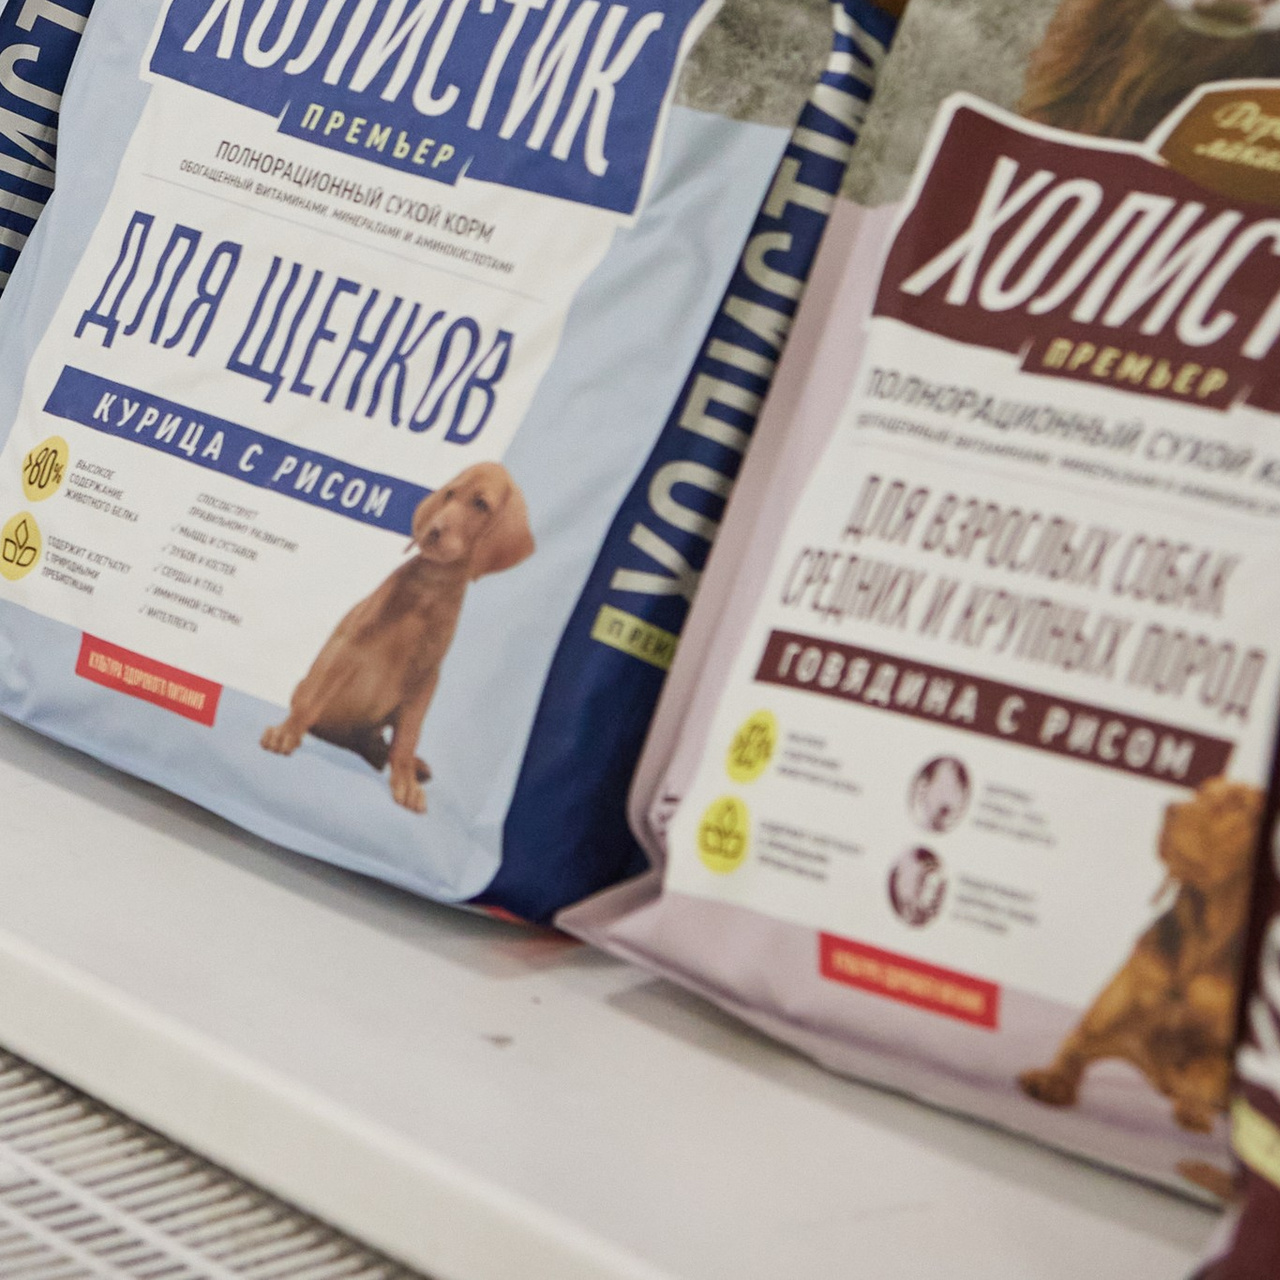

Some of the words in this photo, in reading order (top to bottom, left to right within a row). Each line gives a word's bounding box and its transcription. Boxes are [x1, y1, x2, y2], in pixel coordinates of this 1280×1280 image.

[300, 102, 457, 170] ПРЕМЬЕР
[215, 140, 384, 211] ПОЛНОРАЦИОННЫЙ
[384, 194, 443, 227] СУХОЙ
[443, 211, 497, 244] КОРМ
[73, 208, 244, 359] ДЛЯ
[224, 253, 518, 448] ЩЕНКОВ
[1041, 335, 1231, 401] ПРЕМЬЕР
[91, 389, 226, 464] КУРИЦА
[236, 429, 266, 471] С
[271, 441, 395, 519] РИСОМ
[861, 365, 1145, 455] ПОЛНОРАЦИОННЫЙ
[23, 447, 65, 489] >80%
[775, 640, 980, 726] ГОВЯДИНА
[995, 698, 1028, 735] С
[1039, 704, 1198, 780] РИСОМ
